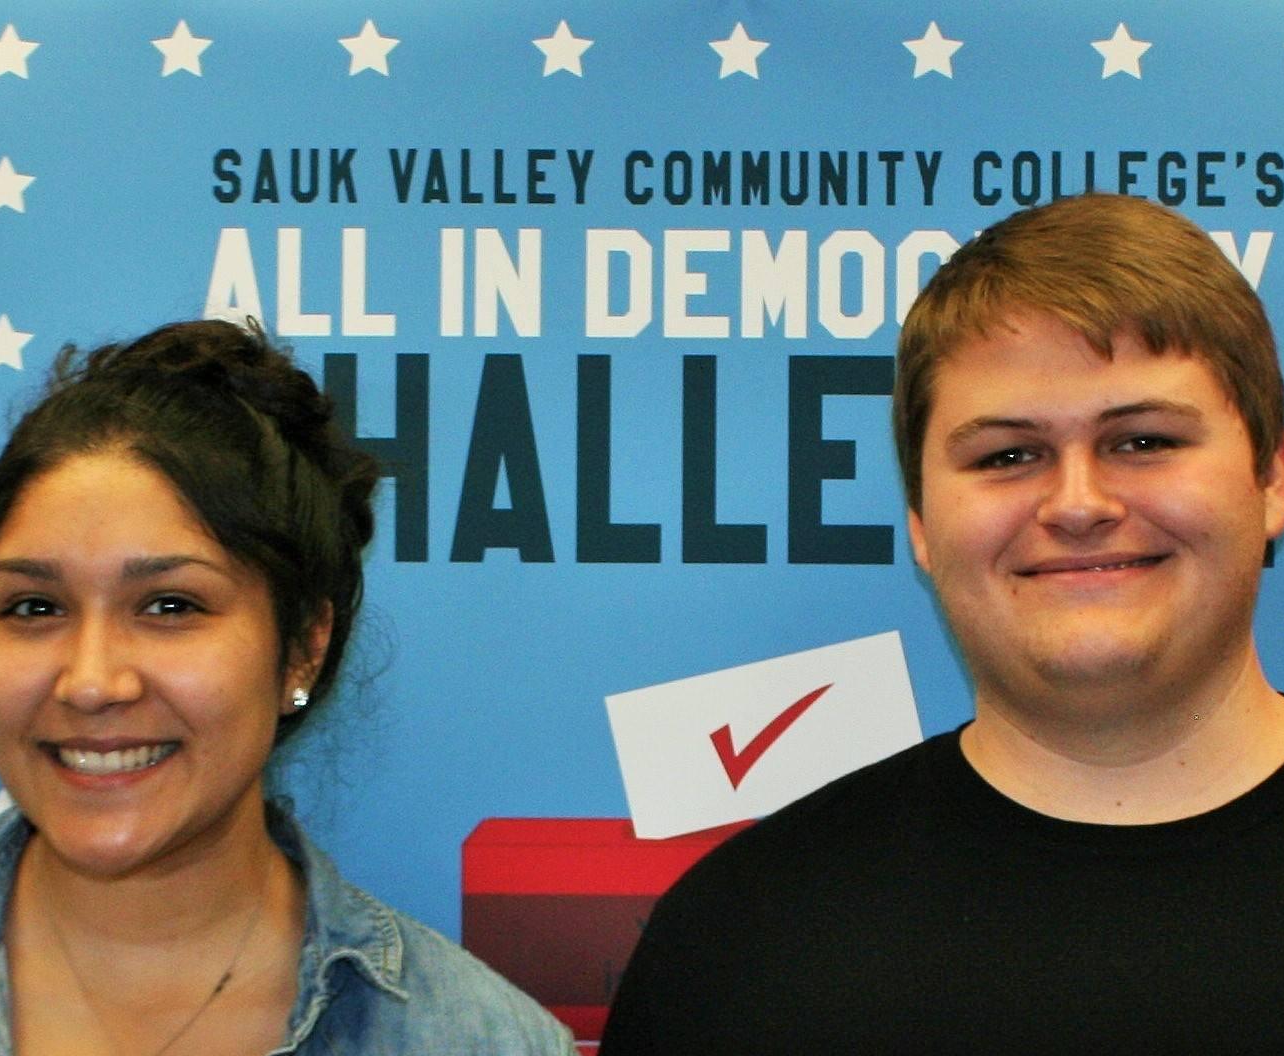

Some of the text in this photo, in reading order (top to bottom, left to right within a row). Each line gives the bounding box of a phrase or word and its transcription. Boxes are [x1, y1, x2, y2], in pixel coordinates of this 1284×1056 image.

[213, 149, 1284, 207] SAUK VALLEY COMMUNITY COLLEGE'S
[202, 228, 396, 337] ALL
[440, 228, 541, 337] IN
